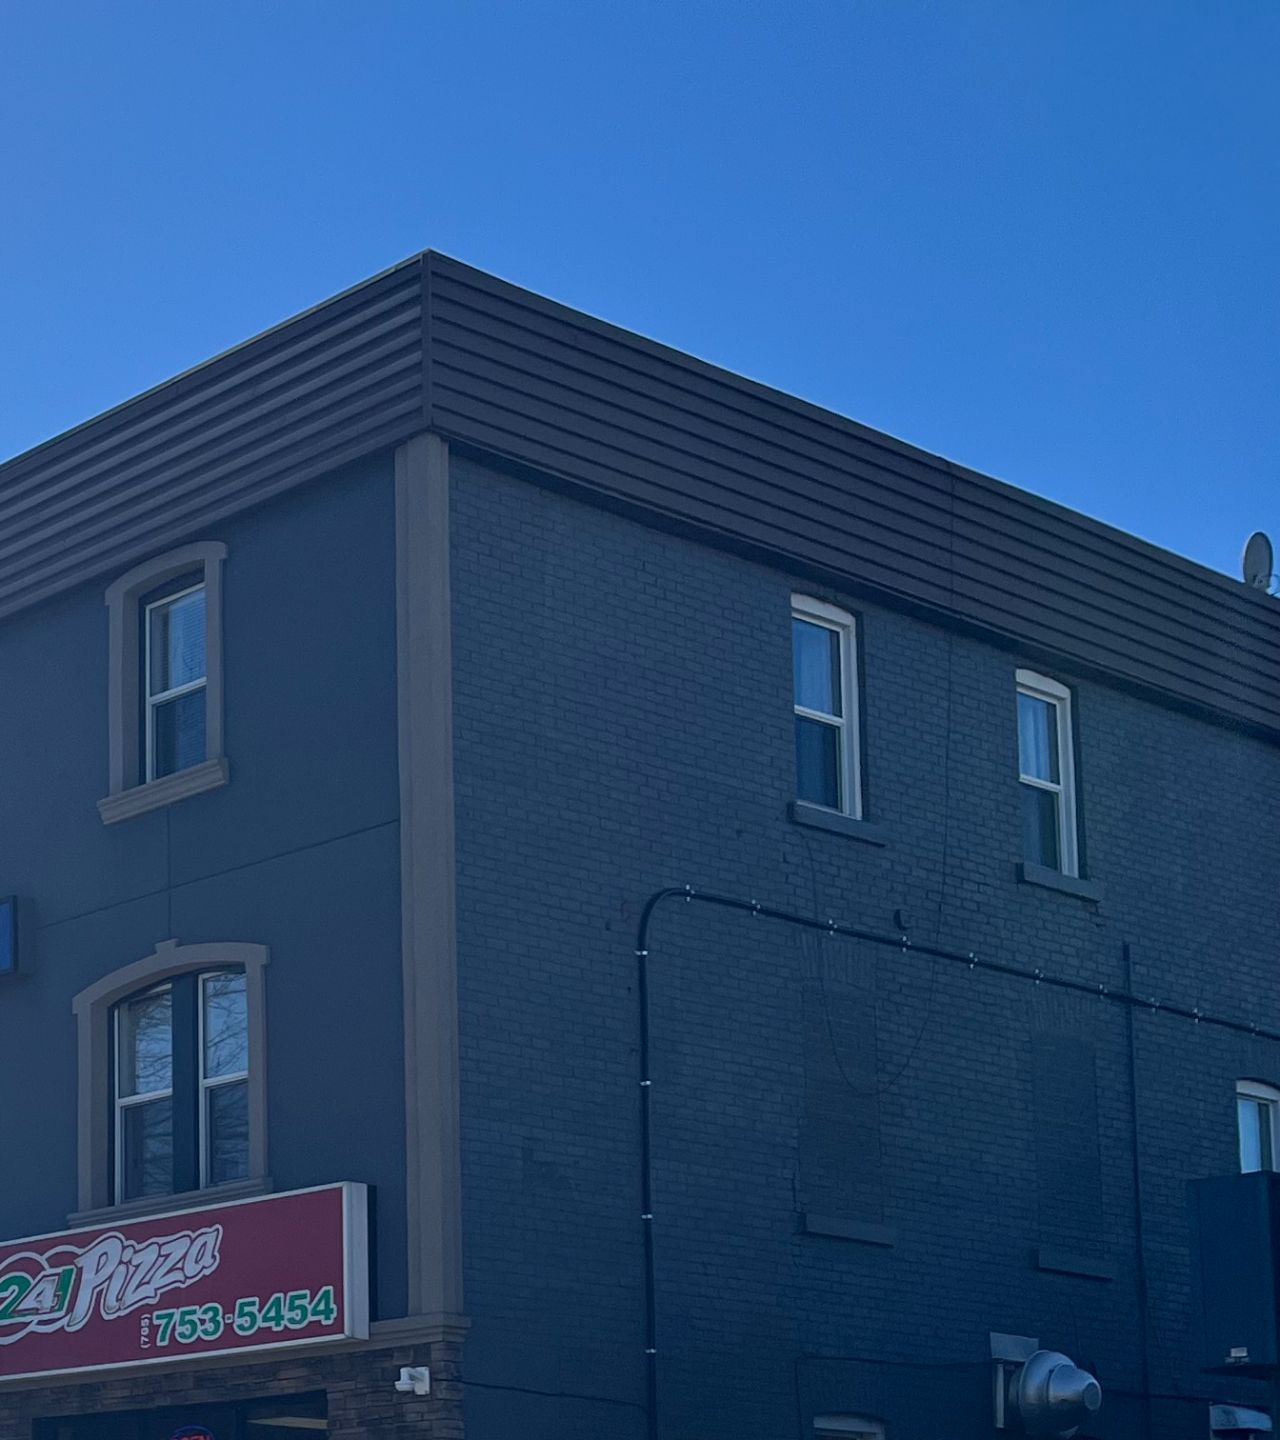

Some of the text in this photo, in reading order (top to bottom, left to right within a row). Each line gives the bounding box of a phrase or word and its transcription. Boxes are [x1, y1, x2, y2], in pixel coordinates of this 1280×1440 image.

[63, 1224, 224, 1333] Pizza
[140, 1286, 337, 1349] (705) 753-5454
